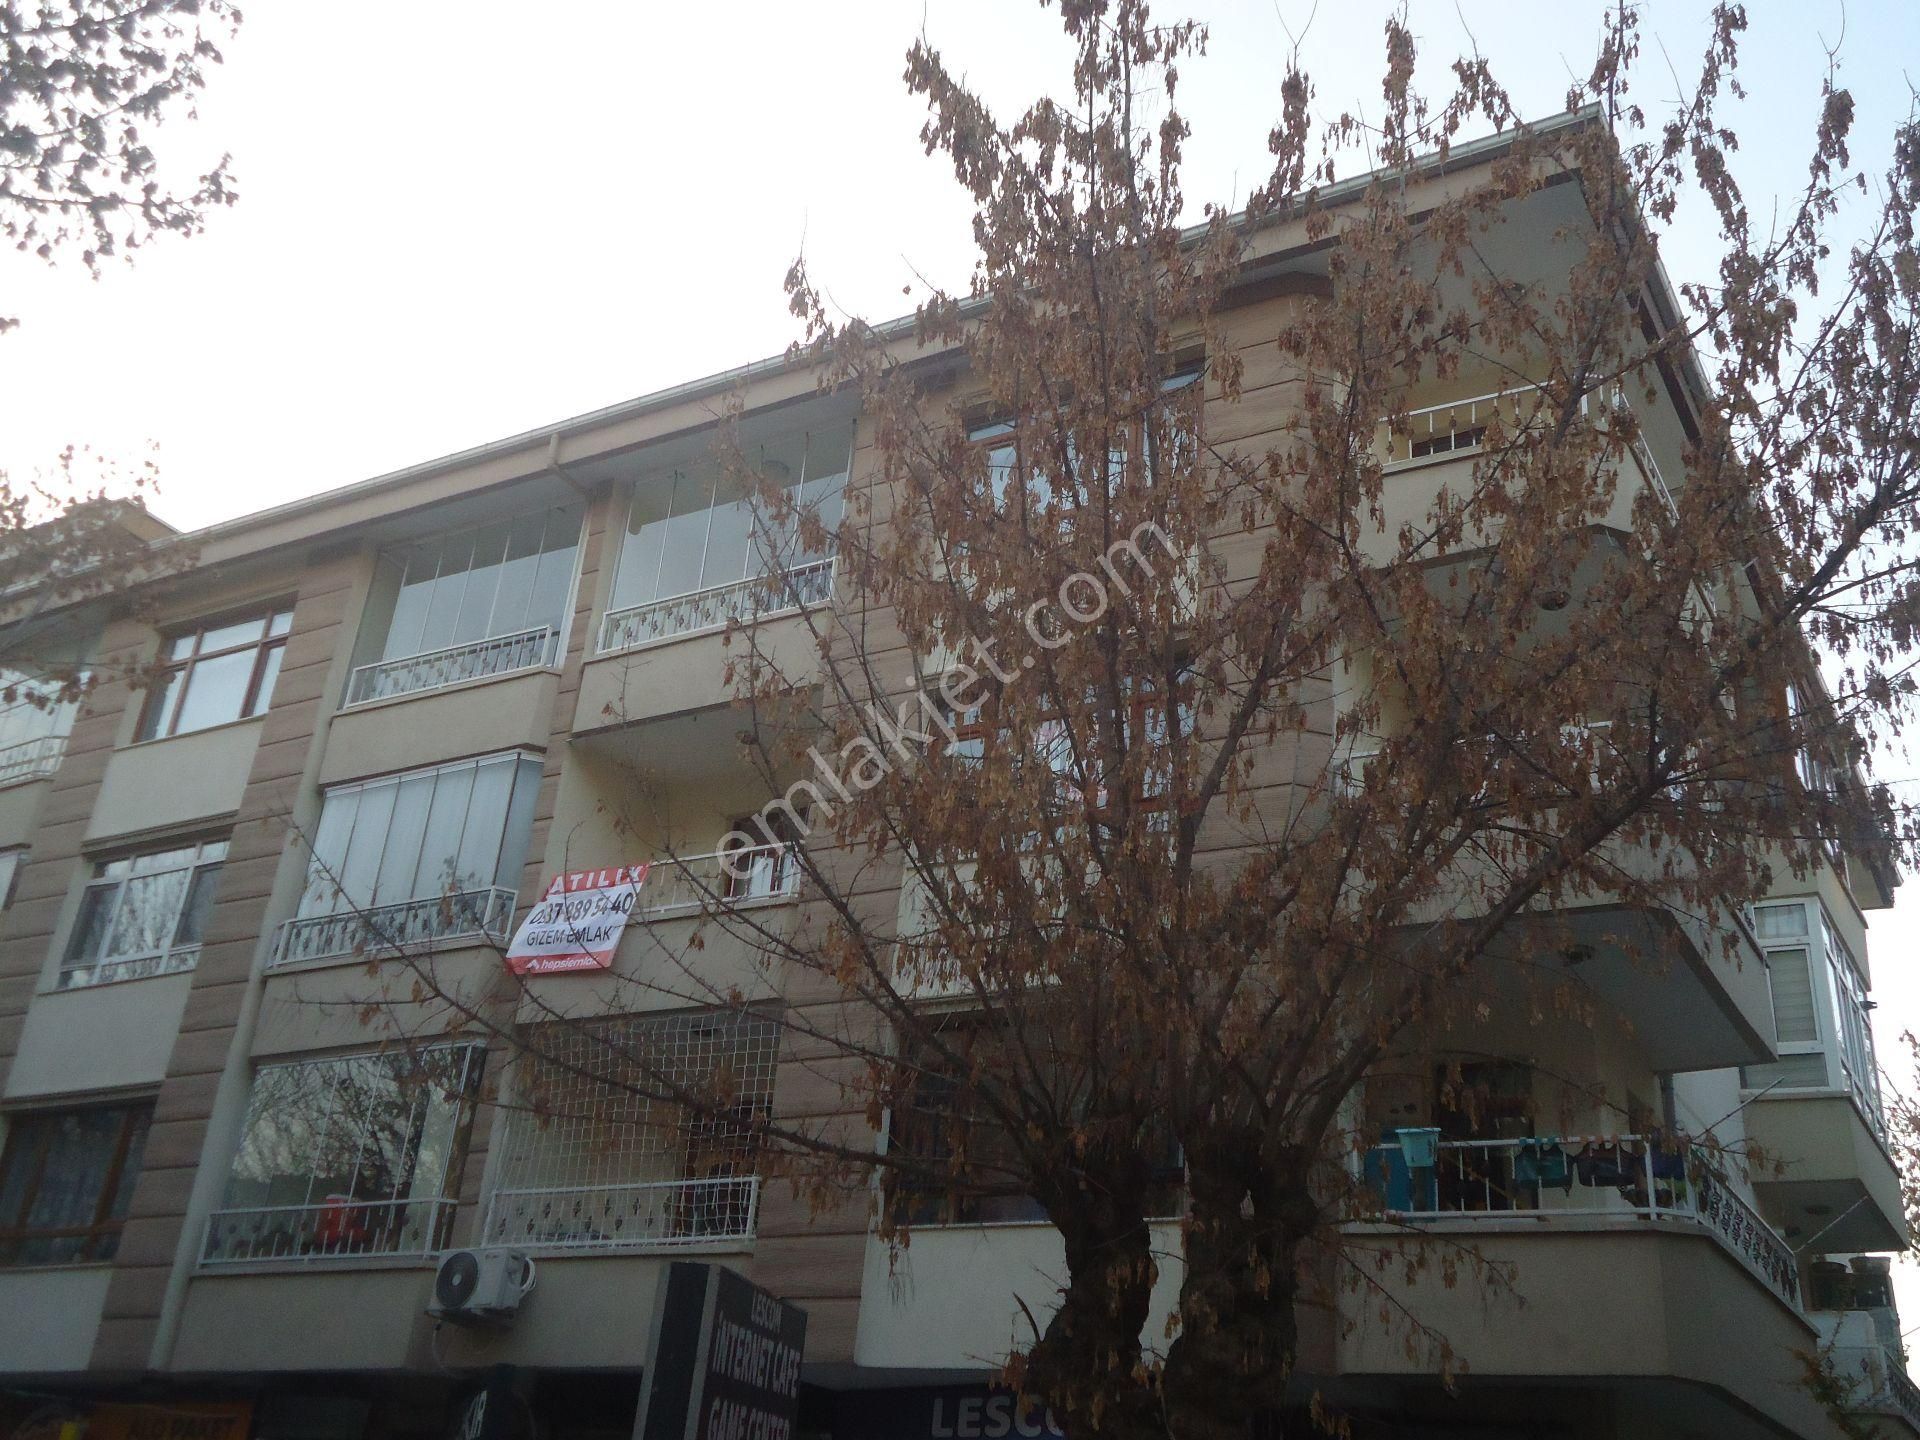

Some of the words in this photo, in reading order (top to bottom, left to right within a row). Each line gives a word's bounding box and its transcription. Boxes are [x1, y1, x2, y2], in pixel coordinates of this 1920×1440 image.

[550, 867, 641, 894] ATILIK
[529, 903, 564, 925] 037
[566, 926, 613, 943] EMLAK
[773, 1341, 801, 1399] CAFE
